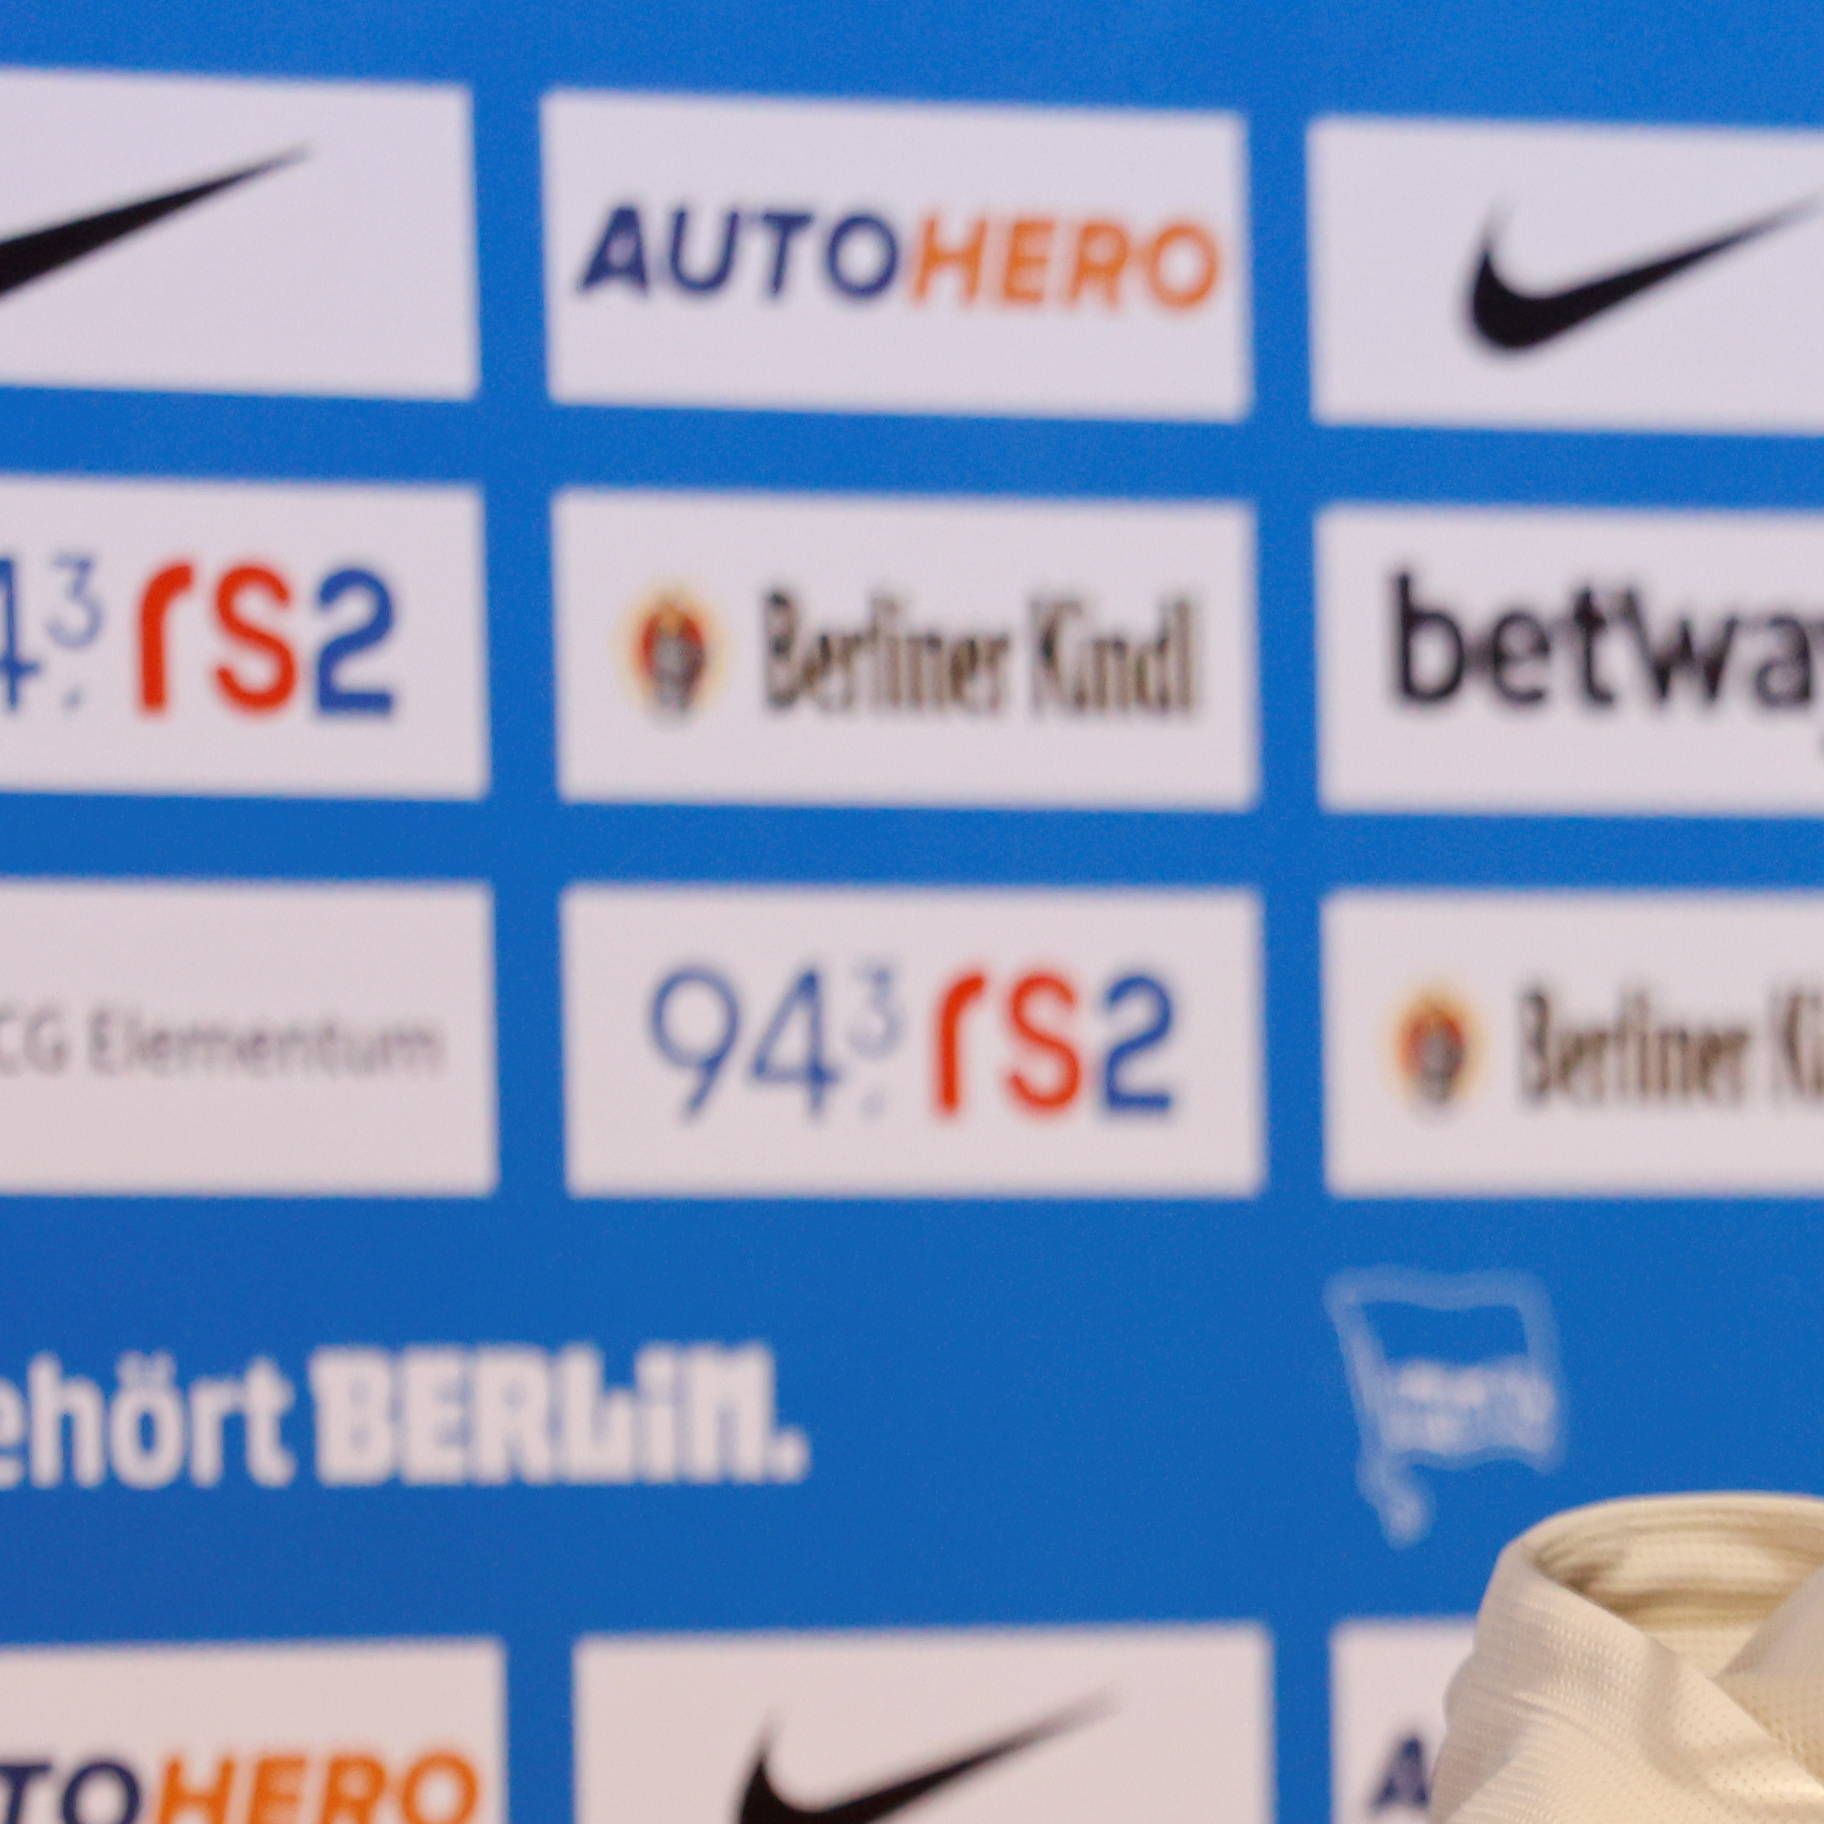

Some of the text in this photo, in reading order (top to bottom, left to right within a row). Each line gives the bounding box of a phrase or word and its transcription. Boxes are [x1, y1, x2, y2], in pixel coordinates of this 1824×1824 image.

[575, 201, 1221, 311] AUTOHERO
[762, 586, 1198, 720] Berliner Kindl
[84, 1002, 446, 1079] Elementum
[1518, 983, 1754, 1106] Berliner
[0, 1353, 295, 1489] hört
